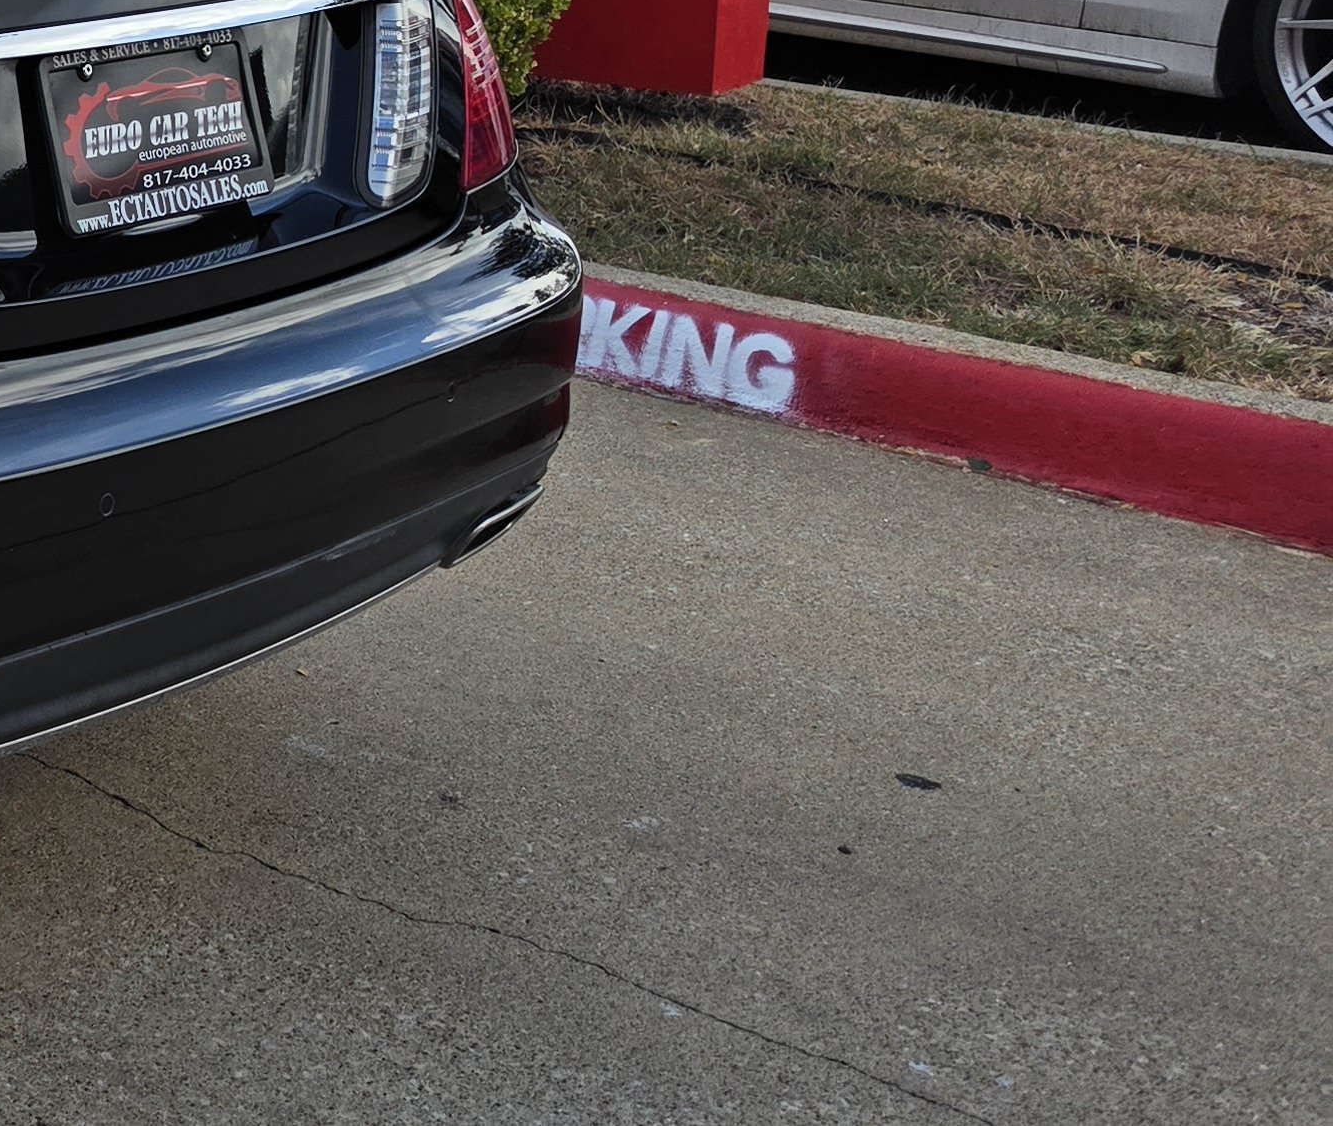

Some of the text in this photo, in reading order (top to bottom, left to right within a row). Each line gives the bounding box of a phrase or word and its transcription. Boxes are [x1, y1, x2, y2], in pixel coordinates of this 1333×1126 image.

[52, 29, 233, 69] SALES & SERVICE 817-404-4033
[85, 100, 244, 159] EURO CAR TECH
[138, 130, 247, 162] european automotive
[143, 154, 252, 189] 817-404-4033
[77, 174, 269, 234] www.ECTAUTOSALES.com
